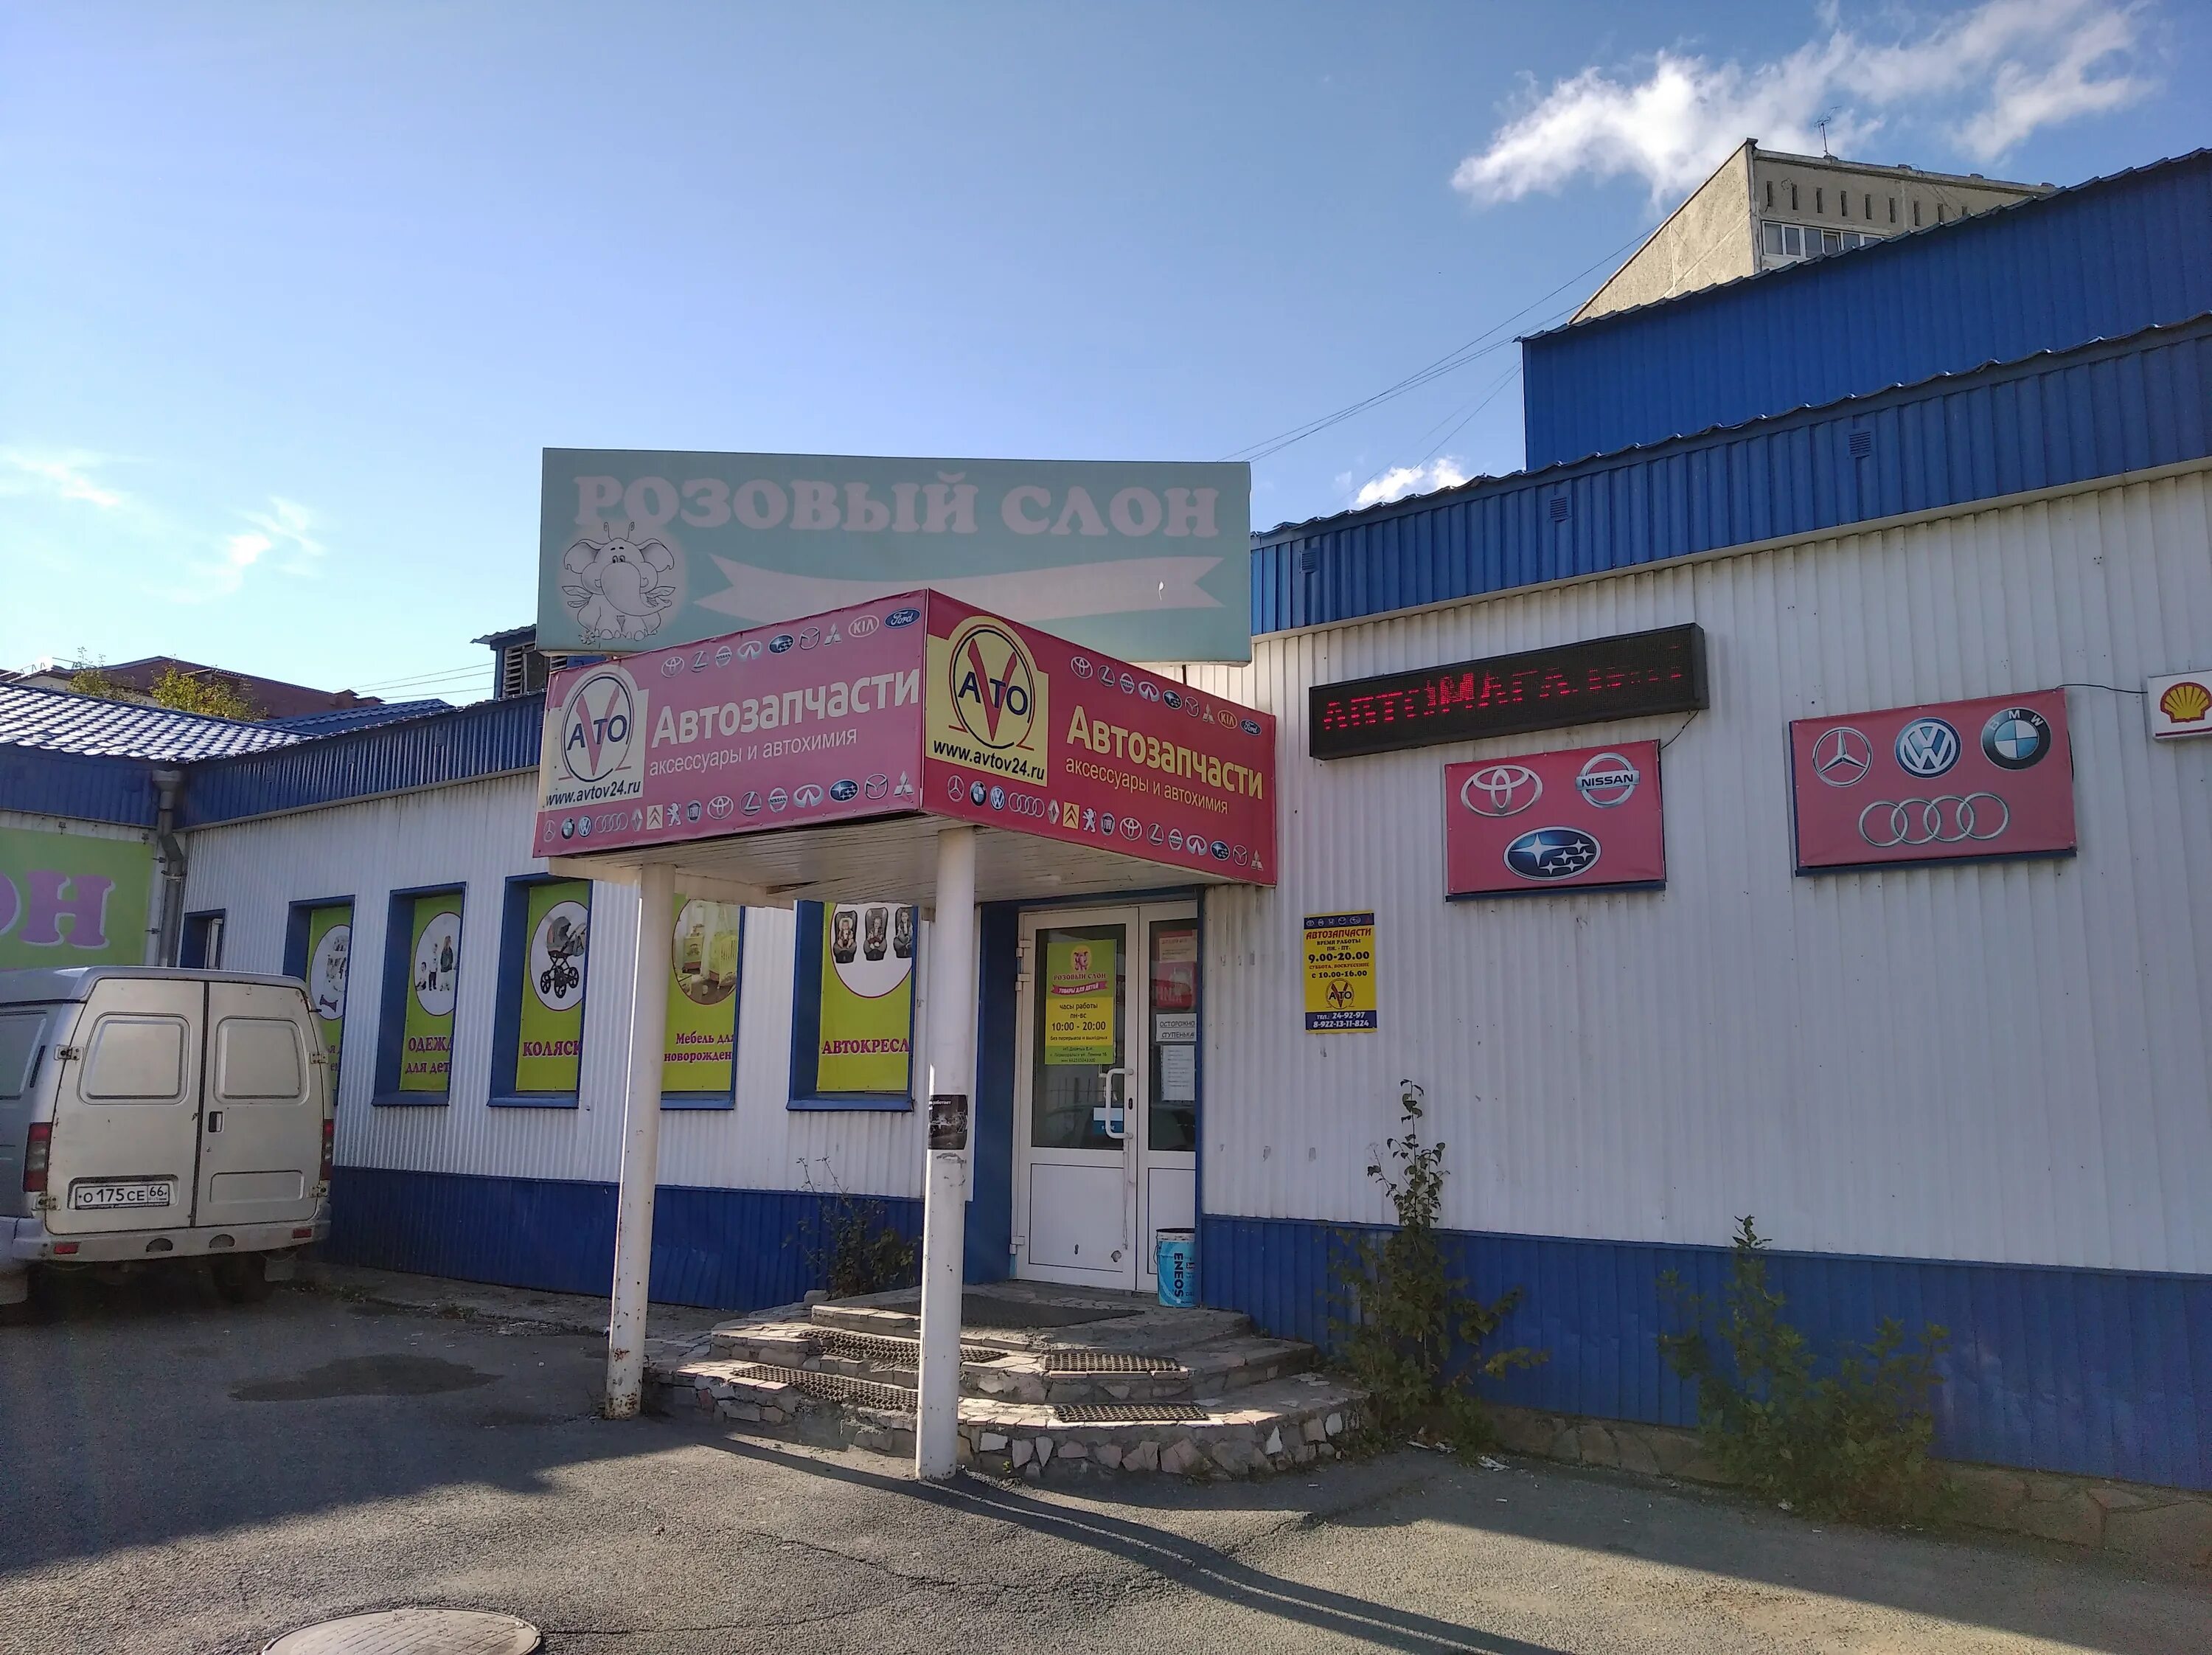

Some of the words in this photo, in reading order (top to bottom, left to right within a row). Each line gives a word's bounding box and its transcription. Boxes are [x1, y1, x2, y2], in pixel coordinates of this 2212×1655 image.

[574, 471, 978, 532] РОЗОВЫЙ
[1001, 485, 1220, 538] СЛОН
[891, 611, 914, 625] Ford
[854, 620, 874, 634] KIA
[651, 668, 920, 749] Автозапчасти
[1221, 712, 1234, 726] KIA
[1244, 721, 1258, 733] Ford
[650, 748, 742, 776] аксессуары
[747, 744, 757, 760] и
[763, 729, 857, 760] автохимия
[1066, 705, 1262, 799] Автозапчасти
[933, 740, 1045, 780] www.avtov24.ru
[1066, 758, 1149, 794] аксессуары
[1153, 783, 1161, 796] и
[1164, 785, 1228, 814] автохимия
[1582, 774, 1633, 787] NISSAN
[546, 780, 641, 807] www.avtov24.ru
[1307, 929, 1371, 940] АВТОЗАПЧАСТИ
[1309, 951, 1369, 963] 9.00-20.00
[1076, 1002, 1098, 1010] работы
[1052, 1022, 1074, 1030] 10:00
[1082, 1021, 1106, 1030] 20:00
[676, 1030, 714, 1044] Мебель
[1174, 1252, 1183, 1297] ENEOS
